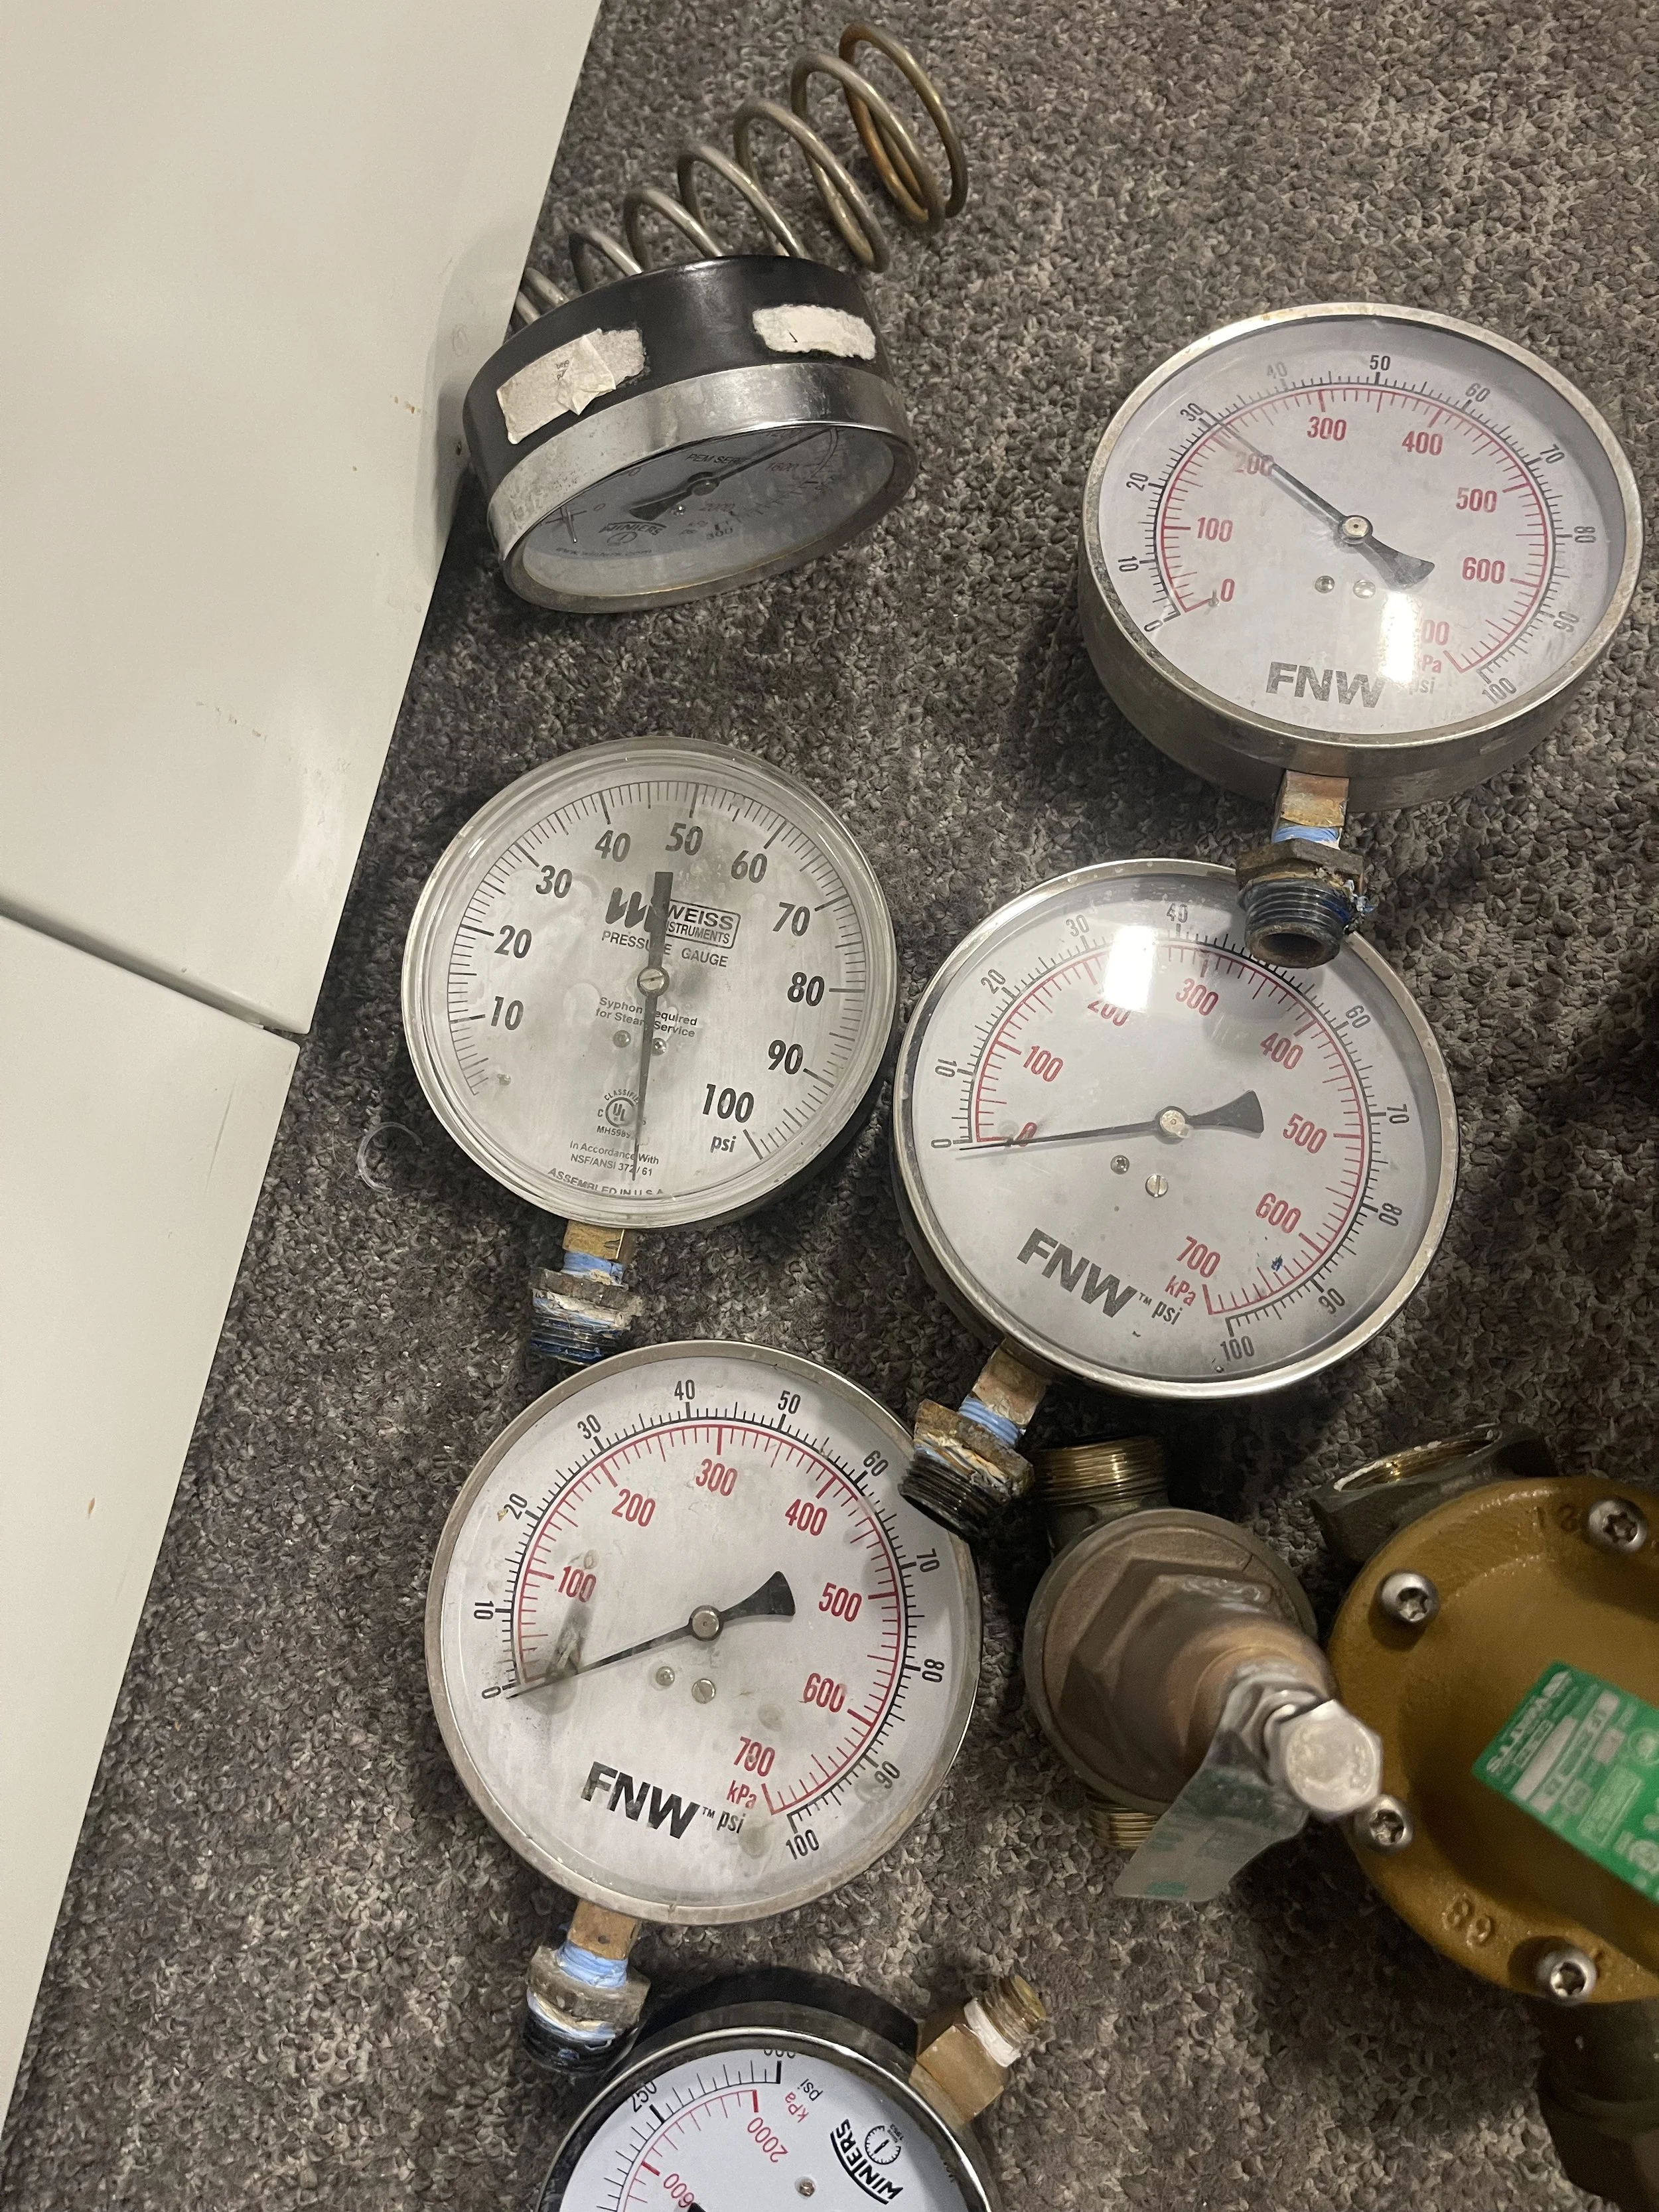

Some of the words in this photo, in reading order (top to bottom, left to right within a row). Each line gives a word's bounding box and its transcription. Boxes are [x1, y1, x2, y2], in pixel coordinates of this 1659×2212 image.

[1267, 362, 1288, 379] 40
[1370, 356, 1391, 371] 50
[1466, 382, 1490, 404] 60
[1181, 404, 1202, 422] 30
[1306, 417, 1346, 441] 300
[1402, 431, 1443, 455] 400
[1540, 444, 1565, 464] 70
[1235, 454, 1273, 476] 200
[1127, 472, 1149, 491] 20
[1457, 489, 1496, 512] 500
[1196, 517, 1232, 542] 100
[1573, 527, 1596, 544] 80
[1118, 556, 1139, 572] 10
[1463, 558, 1505, 584] 600
[1220, 579, 1235, 602] 0
[1144, 619, 1163, 632] 0
[1421, 619, 1449, 646] 00
[1552, 611, 1580, 633] 90
[1422, 655, 1442, 674] Pa
[1266, 661, 1386, 708] FNW
[1481, 678, 1517, 704] 100
[595, 830, 630, 861] 40
[666, 823, 703, 856] 50
[731, 850, 768, 883] 60
[536, 865, 572, 898] 30
[668, 905, 734, 930] WEISS
[772, 902, 810, 936] 70
[1066, 915, 1090, 937] 30
[1167, 904, 1188, 923] 40
[494, 925, 532, 959] 20
[666, 921, 730, 944] STRUMENTS
[602, 930, 672, 955] PRESSUE
[682, 948, 729, 967] GAUGE
[788, 973, 825, 1007] 80
[981, 969, 1005, 994] 20
[1176, 978, 1218, 1016] 300
[490, 996, 524, 1031] 10
[596, 1008, 612, 1019] for
[654, 1021, 695, 1037] Service
[599, 997, 643, 1014] Syphon
[655, 1009, 698, 1026] equired
[1346, 1005, 1372, 1029] 60
[768, 1040, 804, 1076] 90
[1023, 1045, 1064, 1082] 100
[1260, 1032, 1304, 1070] 400
[934, 1058, 957, 1078] 10
[604, 1089, 639, 1104] CLASSIFIE
[702, 1084, 754, 1123] 100
[1386, 1103, 1410, 1124] 70
[711, 1133, 736, 1153] psi
[1283, 1114, 1327, 1155] 500
[569, 1140, 579, 1149] In
[580, 1143, 635, 1161] Accordance
[638, 1153, 659, 1165] With
[571, 1153, 616, 1170] NSF/ANSI
[1256, 1193, 1301, 1234] 600
[1379, 1203, 1403, 1227] 80
[1177, 1236, 1220, 1278] 700
[1016, 1228, 1137, 1318] FNW
[1165, 1274, 1196, 1306] kPa
[1318, 1288, 1346, 1314] 90
[1153, 1300, 1183, 1326] psi
[1220, 1335, 1255, 1361] 100
[674, 1379, 696, 1400] 40
[778, 1390, 801, 1414] 50
[577, 1414, 601, 1439] 30
[863, 1449, 889, 1477] 60
[695, 1459, 738, 1496] 300
[504, 1493, 528, 1520] 20
[611, 1488, 656, 1527] 200
[784, 1499, 829, 1536] 400
[916, 1547, 940, 1571] 70
[558, 1566, 597, 1603] 100
[474, 1600, 494, 1620] 10
[818, 1583, 863, 1621] 500
[922, 1658, 946, 1683] 80
[482, 1686, 501, 1699] 0
[802, 1673, 846, 1712] 600
[734, 1736, 775, 1777] 700
[874, 1760, 901, 1789] 90
[580, 1760, 701, 1839] FNW
[725, 1780, 757, 1810] kPa
[717, 1810, 745, 1834] psi
[786, 1829, 820, 1860] 100
[800, 2079, 823, 2101] psi
[784, 2092, 810, 2123] kPa
[747, 2117, 788, 2163] 2000
[830, 2118, 903, 2205] WINTERS
[663, 2173, 695, 2208] 600
